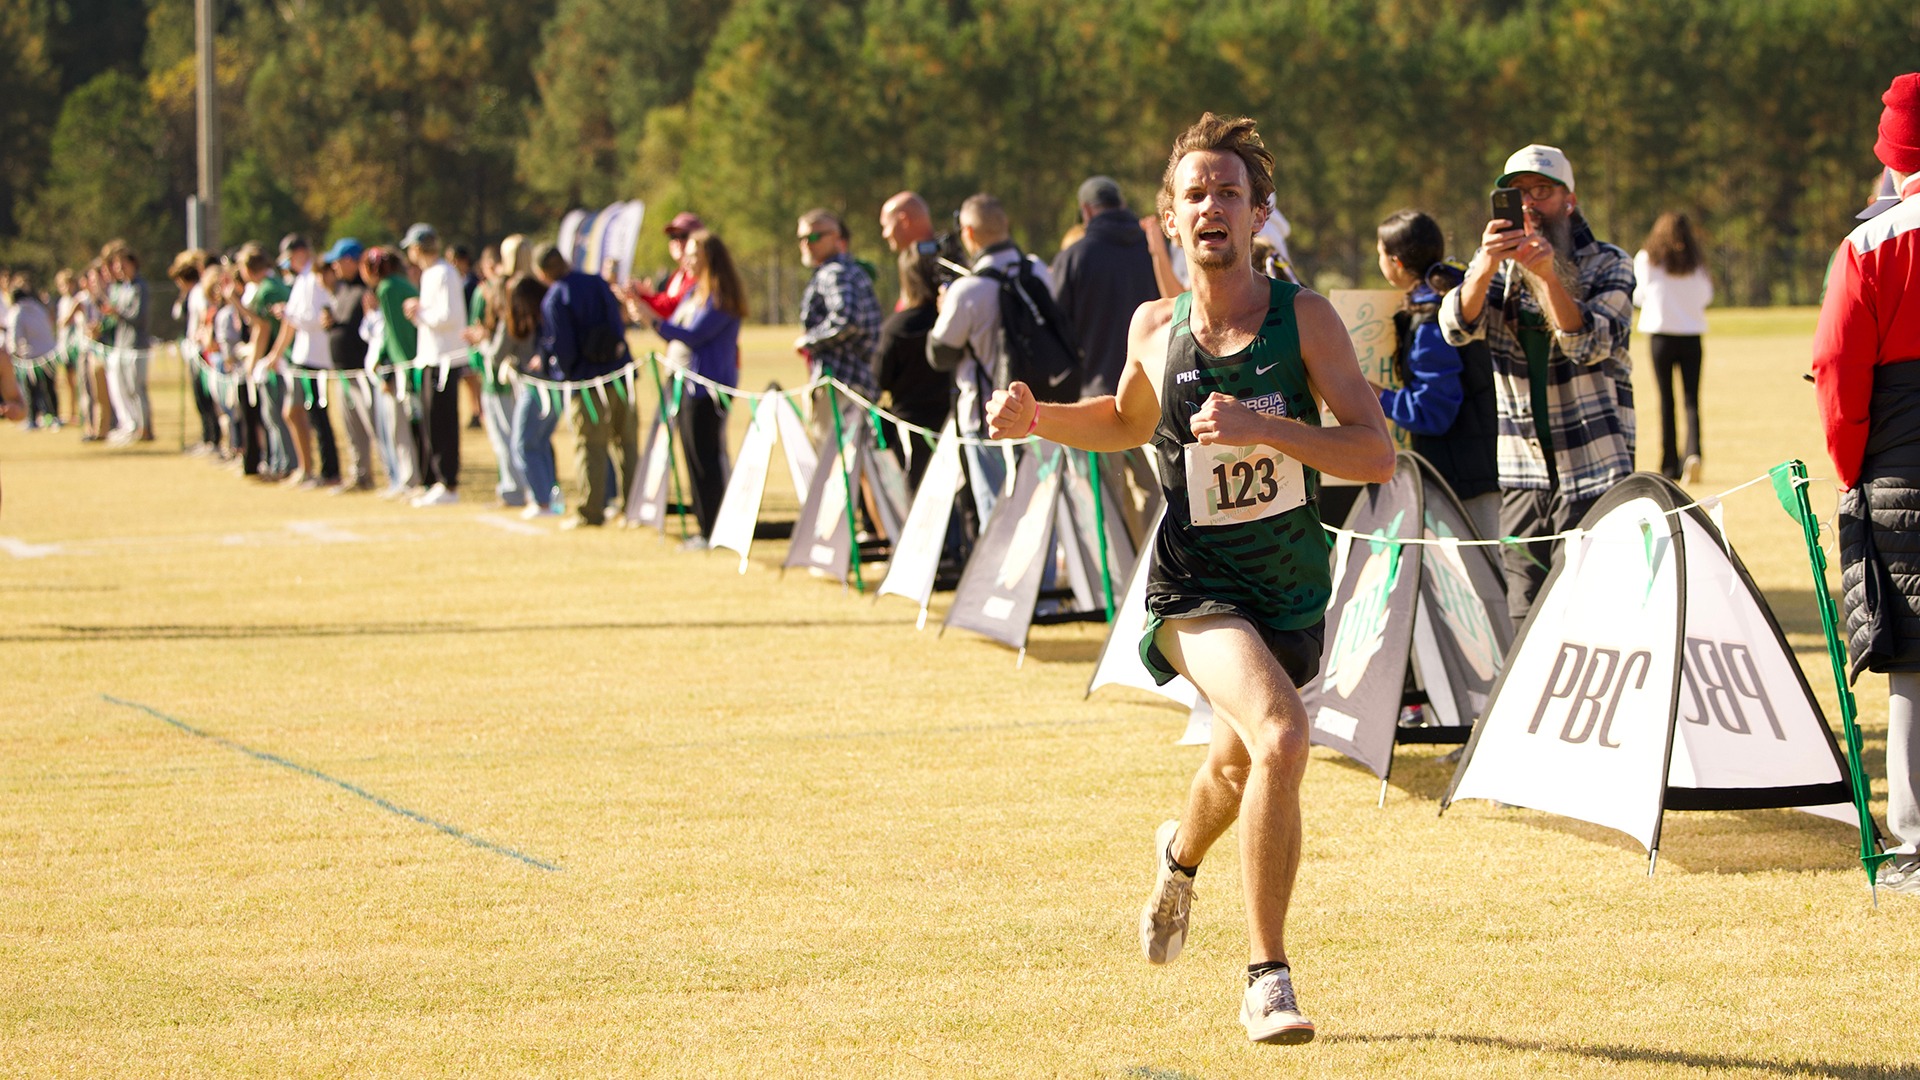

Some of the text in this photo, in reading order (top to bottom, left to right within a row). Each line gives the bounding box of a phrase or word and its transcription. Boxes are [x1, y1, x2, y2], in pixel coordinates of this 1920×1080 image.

[1176, 369, 1200, 385] PBC
[1212, 457, 1279, 511] 123
[1527, 641, 1653, 749] PBC
